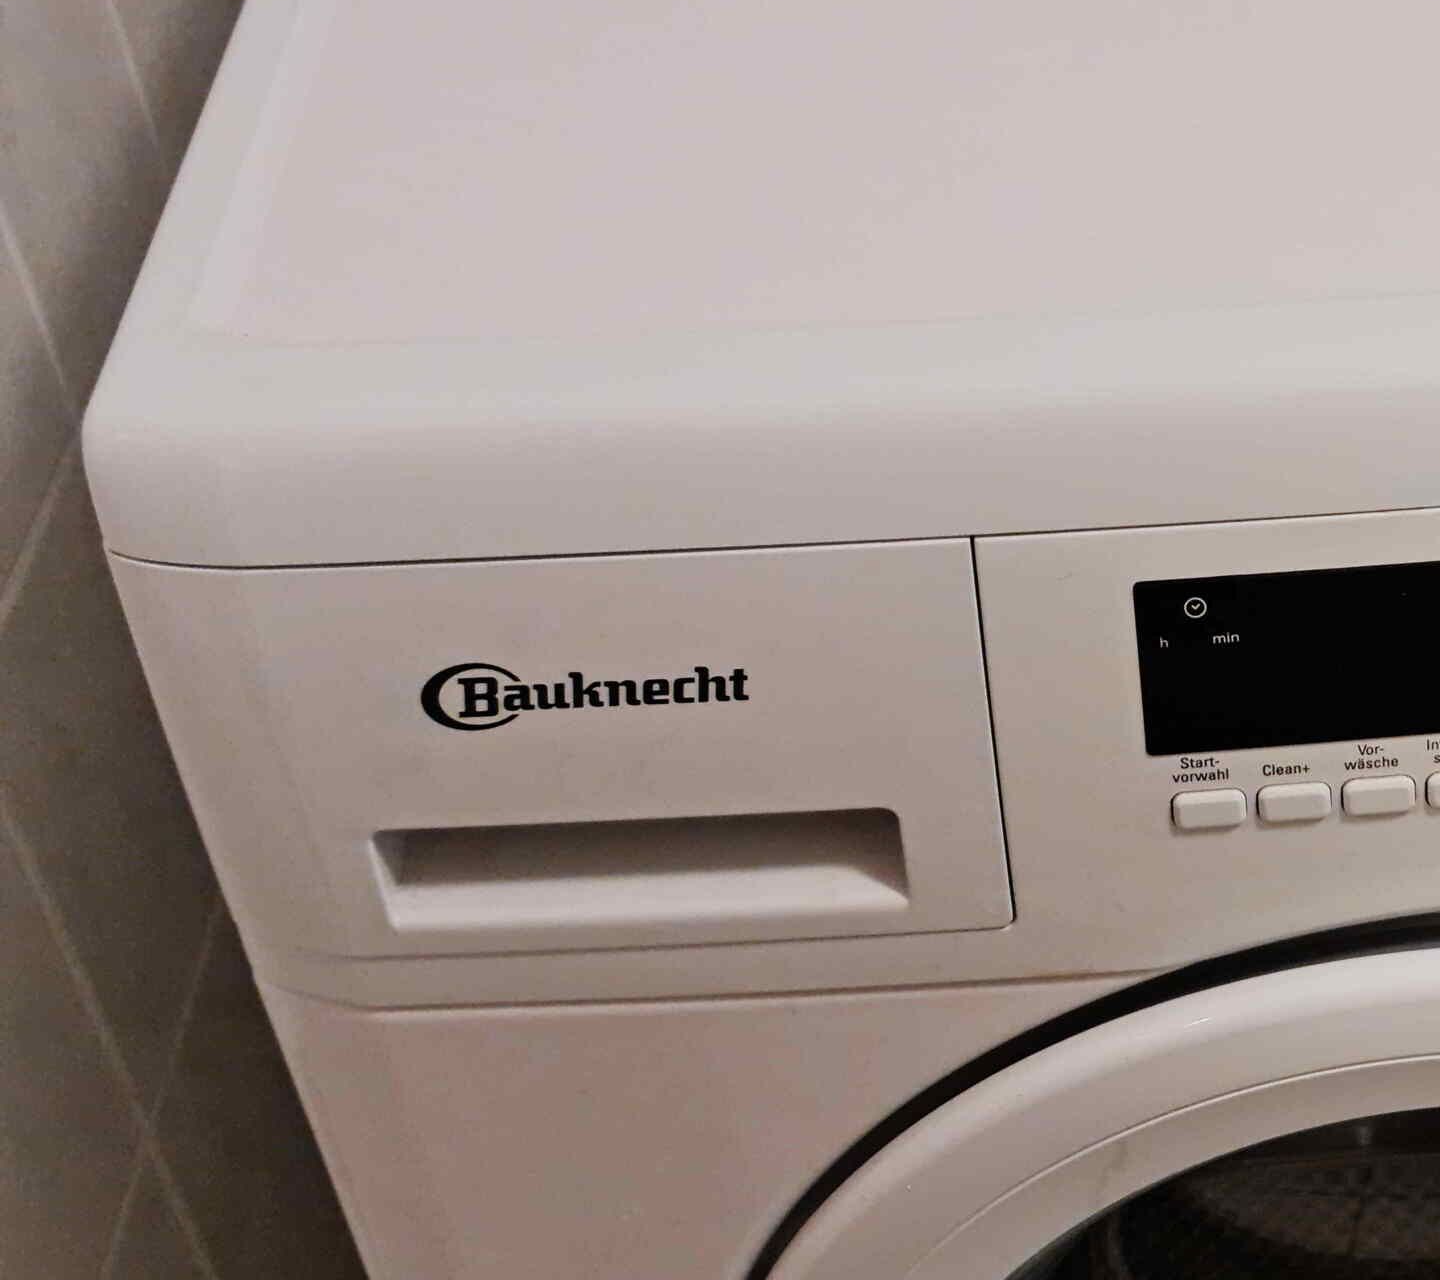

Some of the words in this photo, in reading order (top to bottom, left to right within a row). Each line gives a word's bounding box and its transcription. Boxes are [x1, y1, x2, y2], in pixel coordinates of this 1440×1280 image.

[1159, 635, 1169, 648] h
[1212, 632, 1240, 645] min
[458, 667, 749, 718] Bauknecht
[1357, 744, 1385, 757] Vor-
[1179, 756, 1221, 771] Start-
[1262, 762, 1311, 777] Clean+
[1344, 755, 1399, 770] wäsche
[1172, 767, 1230, 783] vorwahl
